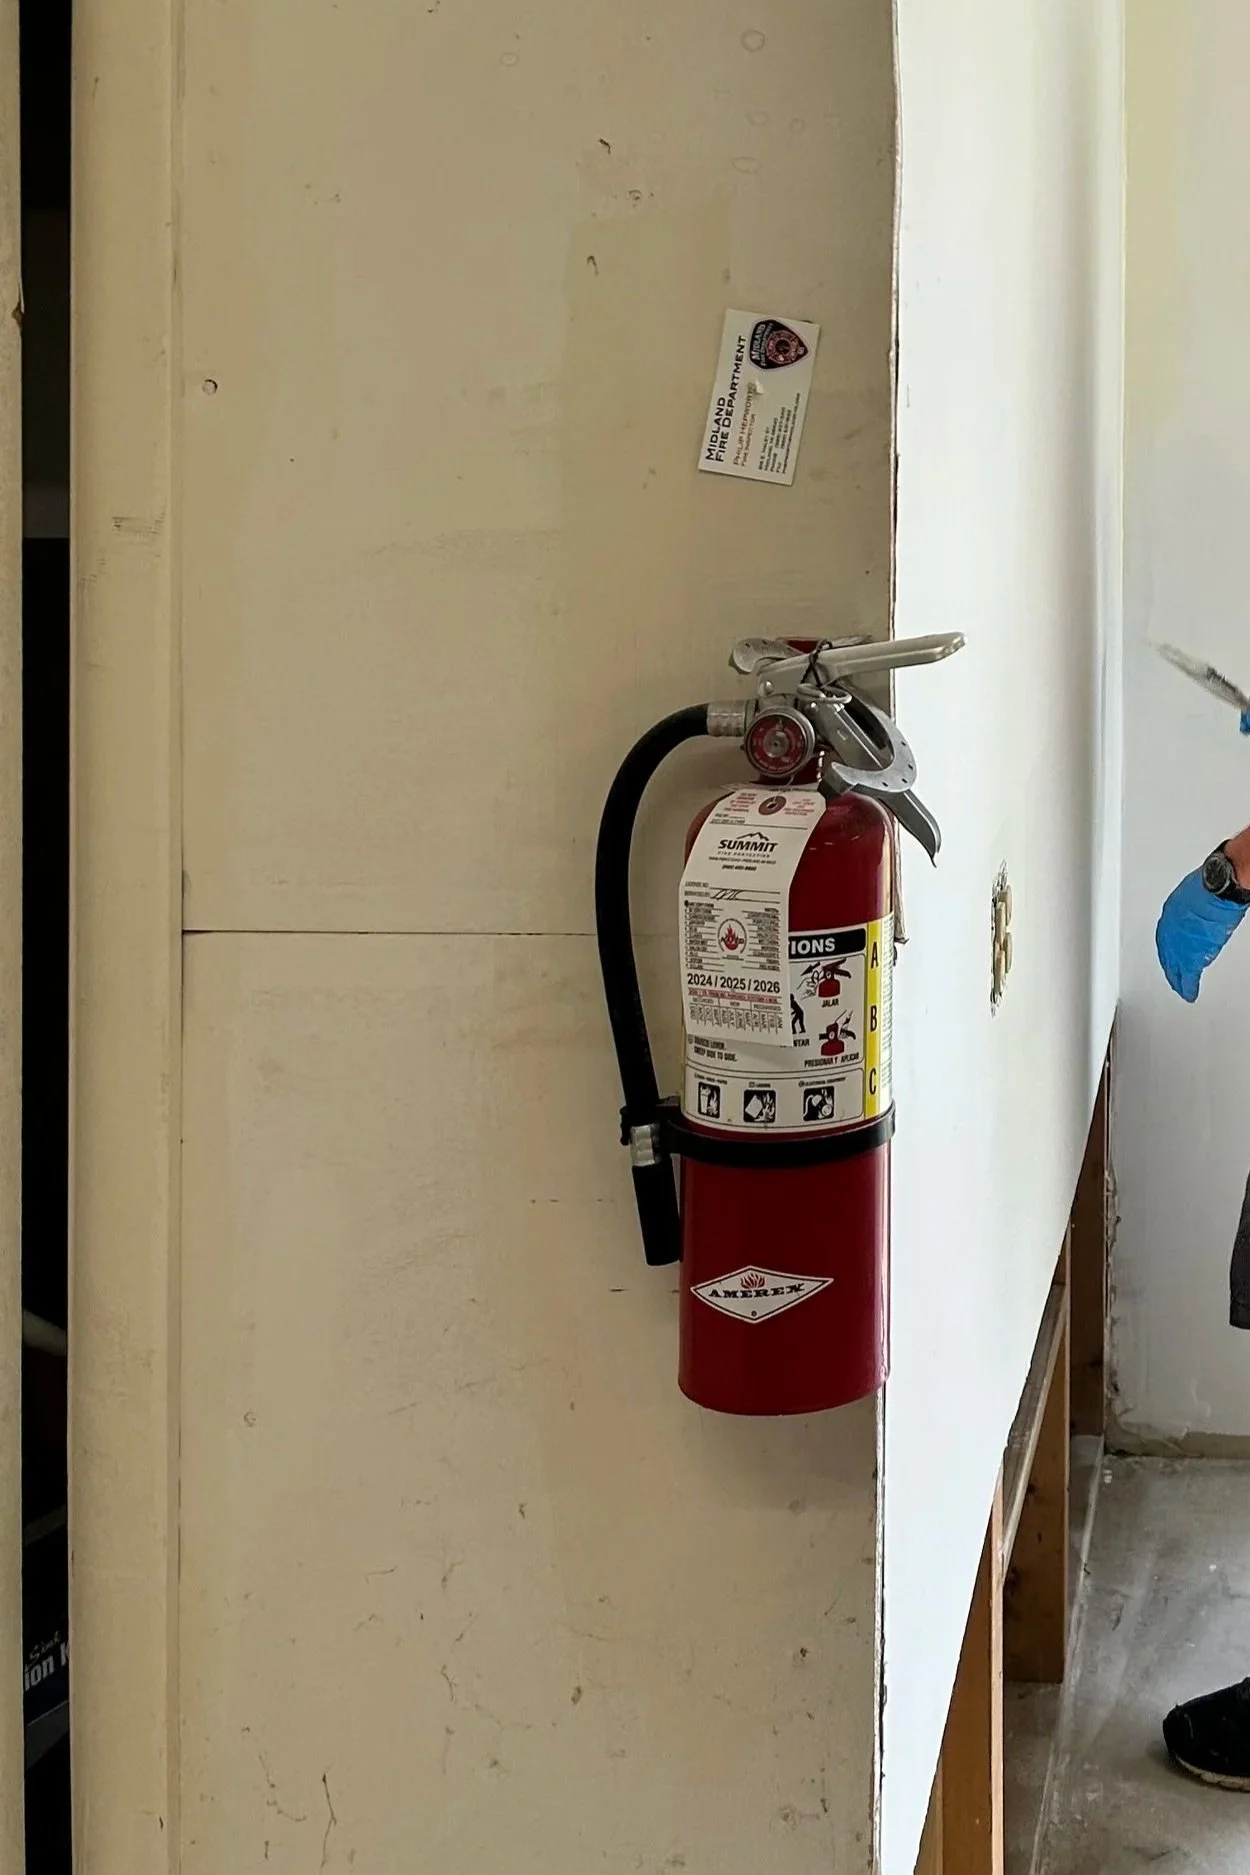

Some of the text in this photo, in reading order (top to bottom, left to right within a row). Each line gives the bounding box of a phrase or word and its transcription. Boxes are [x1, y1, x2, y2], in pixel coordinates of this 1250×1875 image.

[715, 335, 746, 462] FIRE DEPARTMENT
[705, 397, 726, 461] MIDLAND
[718, 839, 778, 852] SUMMIT
[789, 937, 836, 955] IONS
[871, 942, 878, 969] A
[687, 973, 713, 987] 2024
[720, 976, 746, 990] 2025
[753, 980, 781, 993] 2026
[821, 998, 839, 1008] JALAR
[870, 1005, 877, 1032] B
[793, 1039, 810, 1047] NTAR
[869, 1068, 877, 1095] C
[708, 1283, 805, 1299] AMEREX
[24, 1655, 55, 1692] ion
